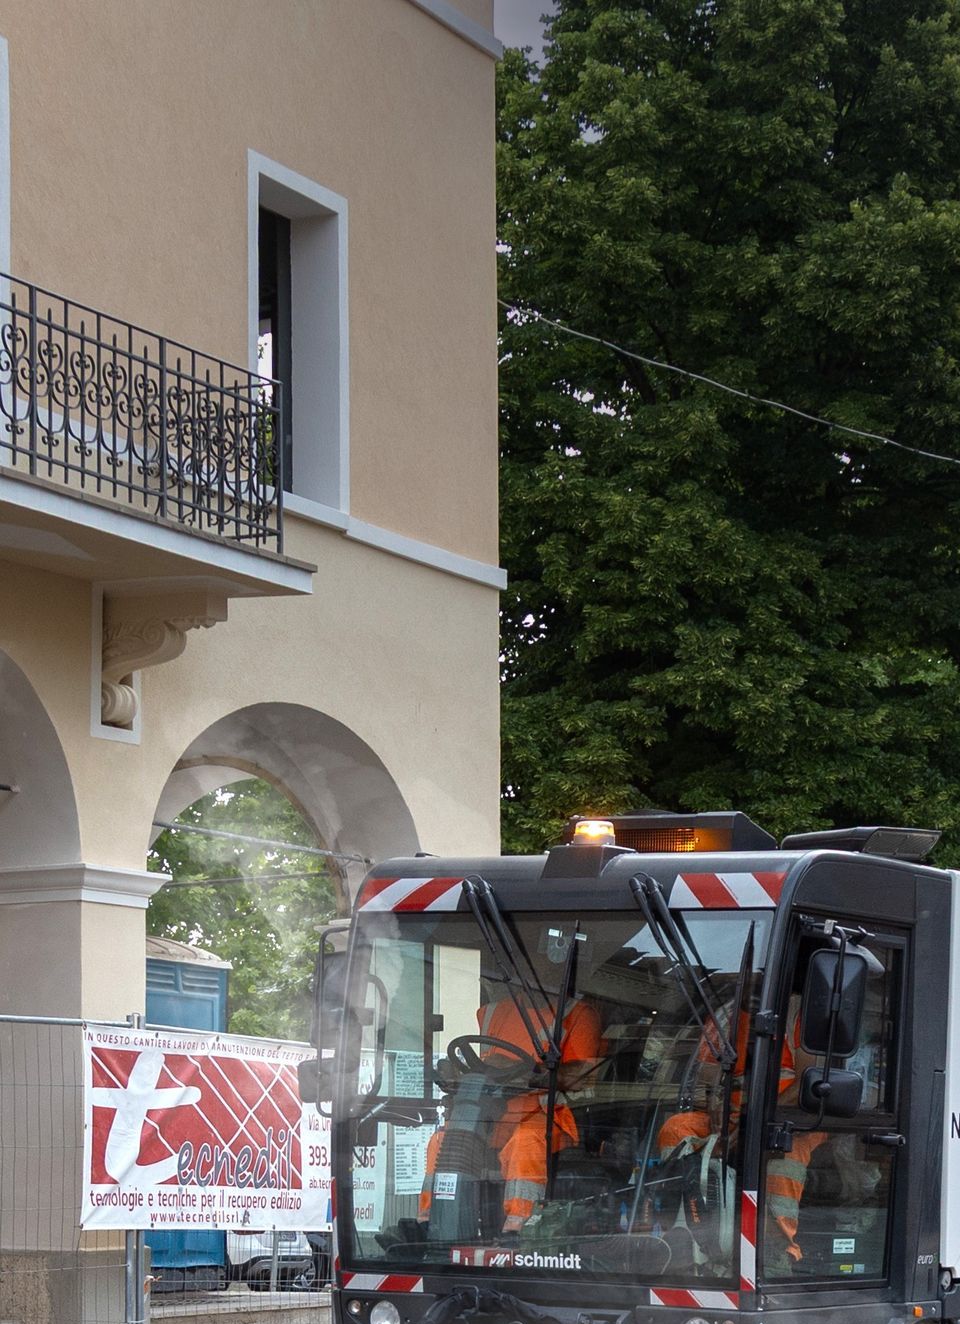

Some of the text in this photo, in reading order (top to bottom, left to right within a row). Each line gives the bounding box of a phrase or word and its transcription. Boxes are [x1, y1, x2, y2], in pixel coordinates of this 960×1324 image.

[84, 1031, 94, 1041] IN
[96, 1033, 130, 1045] QUESTO
[133, 1036, 172, 1048] CANTIERE
[173, 1039, 199, 1050] LAVORI
[266, 1049, 280, 1058] DEL
[282, 1052, 303, 1061] TETTO
[308, 1114, 320, 1131] Via
[147, 1193, 154, 1206] e
[157, 1188, 197, 1207] tecniche
[201, 1194, 216, 1212] per
[219, 1189, 225, 1207] il
[227, 1194, 267, 1210] recupero
[270, 1190, 302, 1210] edilizio
[514, 1251, 582, 1269] schmidt
